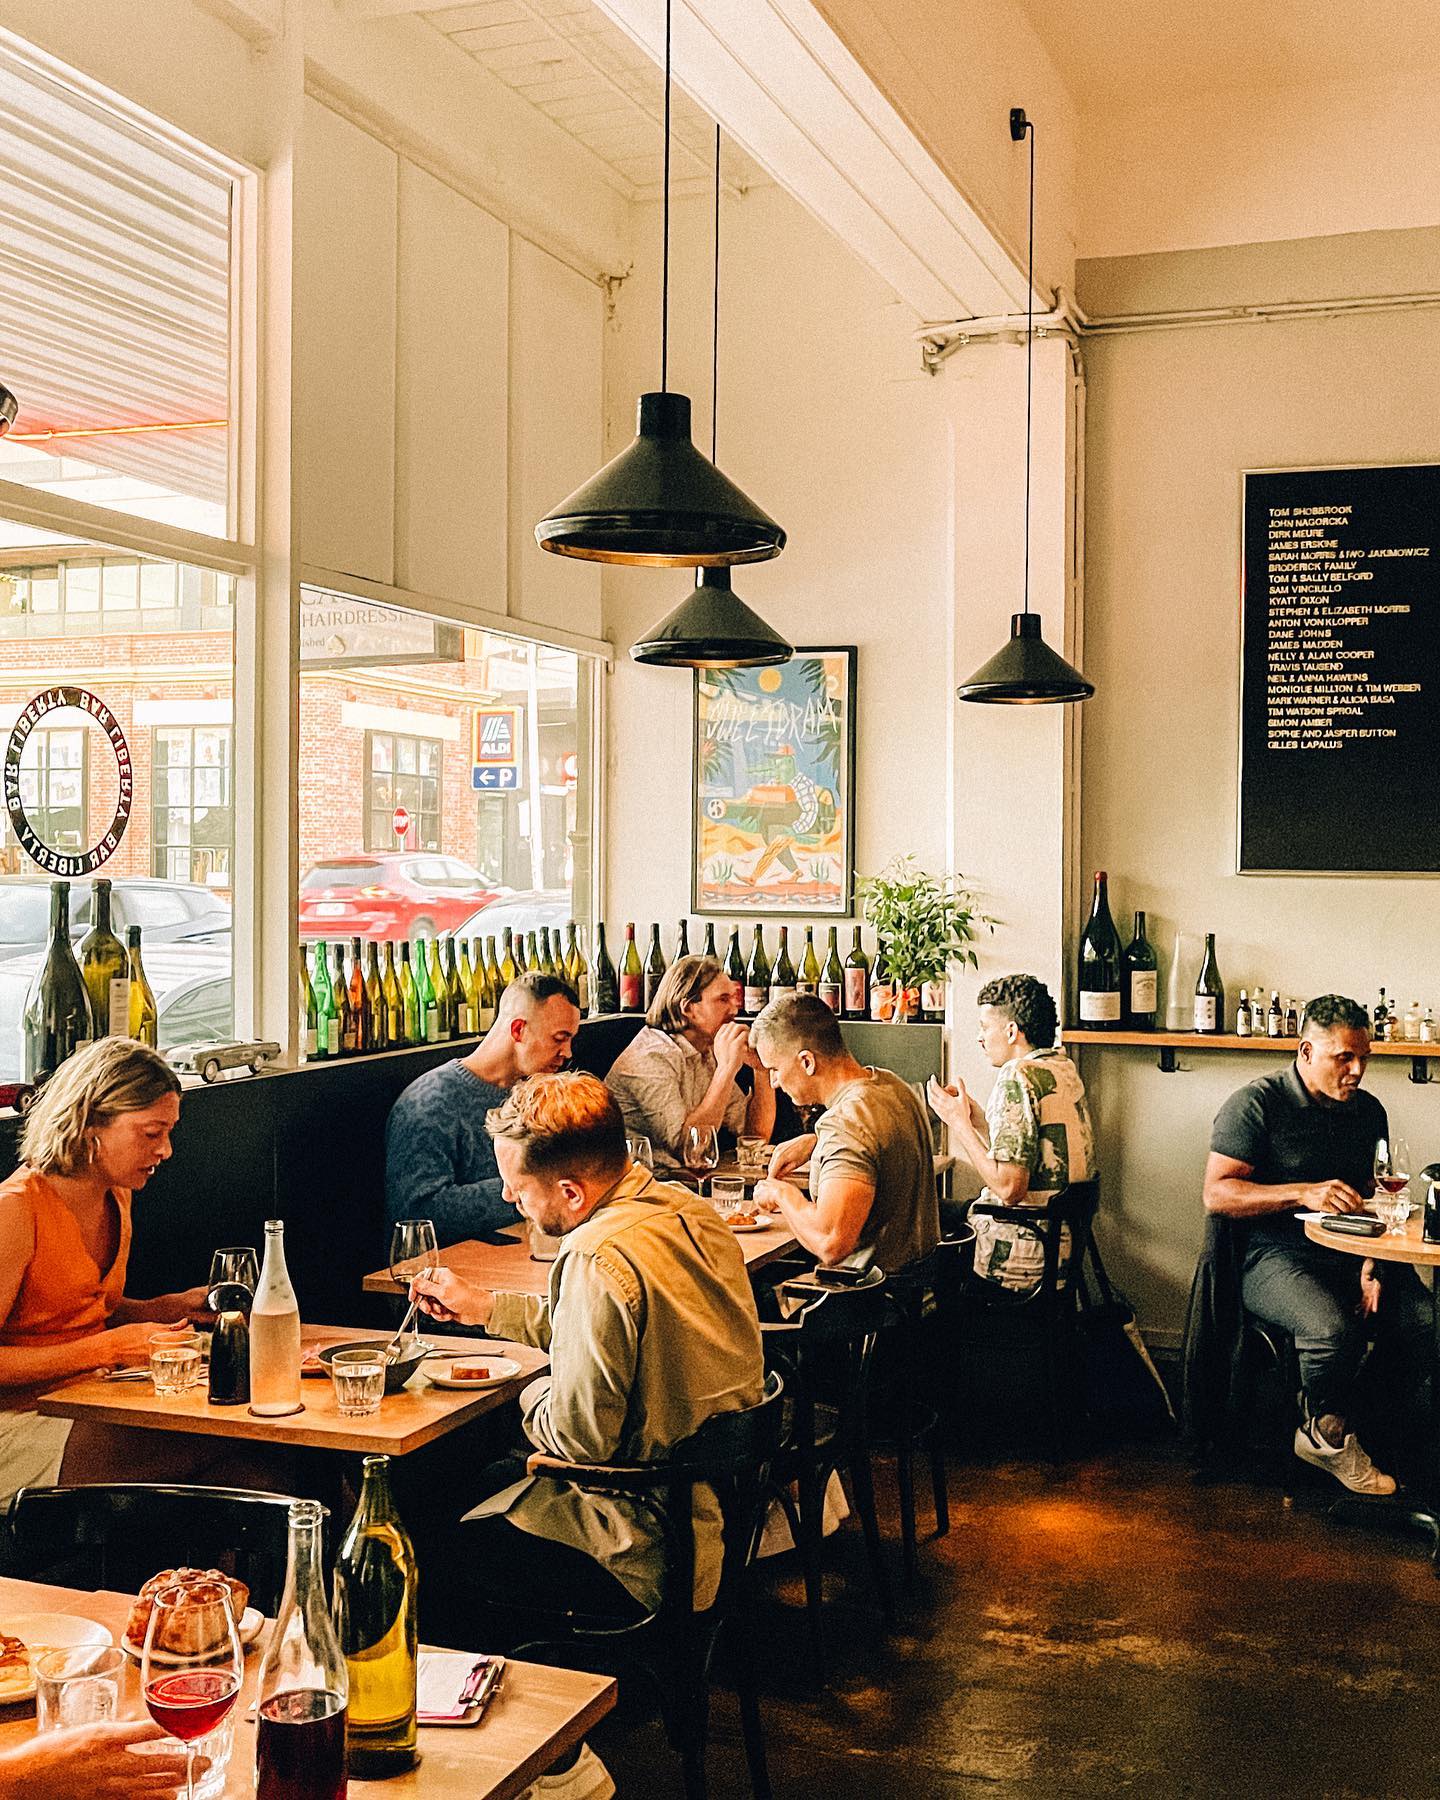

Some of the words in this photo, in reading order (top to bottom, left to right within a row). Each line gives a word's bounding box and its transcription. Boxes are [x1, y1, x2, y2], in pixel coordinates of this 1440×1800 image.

[1269, 508, 1289, 517] TOM
[1269, 519, 1293, 528] JOHN
[1269, 530, 1291, 539] DIRK
[1293, 529, 1324, 538] MEURE
[1268, 542, 1298, 551] JAMES
[1300, 540, 1338, 549] ERSKINE
[1269, 552, 1299, 561] SARAH
[1339, 550, 1344, 559] &
[1269, 563, 1321, 572] BRODERICK
[1325, 561, 1357, 570] FAMILY
[1269, 575, 1289, 584] TOM
[1292, 574, 1297, 583] &
[1300, 573, 1329, 582] SALLY
[1330, 573, 1373, 582] BELFORD
[1269, 586, 1288, 595] SAM
[1292, 585, 1341, 594] VINCIULLO
[1270, 597, 1297, 606] KYATT
[1300, 596, 1329, 605] DIXON
[1269, 608, 1310, 617] STEPHEN
[1313, 607, 1319, 616] &
[1322, 606, 1372, 615] ELIZABETH
[1268, 619, 1300, 628] ANTON
[1304, 618, 1324, 627] VON
[1326, 617, 1368, 626] KLOPPER
[1269, 630, 1294, 639] DANE
[1298, 629, 1331, 638] JOHNS
[1269, 641, 1300, 650] JAMES
[1303, 640, 1343, 649] MADDEN
[1268, 652, 1296, 661] NELLY
[1299, 652, 1304, 661] &
[1308, 651, 1333, 660] ALAN
[1336, 650, 1374, 659] COOPER
[1269, 663, 1300, 672] TRAVIS
[1268, 674, 1287, 683] NEIL
[1289, 674, 1295, 683] &
[1297, 674, 1325, 683] ANNA
[1357, 684, 1363, 693] &
[1365, 684, 1381, 693] TIM
[1267, 696, 1292, 705] MARK
[1293, 696, 1331, 705] WARNER
[1333, 696, 1338, 705] &
[1340, 695, 1369, 704] ALICIA
[1370, 695, 1395, 704] BASA
[1268, 707, 1283, 716] TIM
[1286, 707, 1324, 716] WATSON
[1268, 718, 1298, 727] SIMON
[1268, 730, 1300, 739] SOPHIE
[1302, 729, 1322, 738] AND
[1323, 729, 1358, 738] JASPER
[1359, 729, 1396, 738] BUTTON
[480, 742, 511, 756] ALDI
[1268, 741, 1298, 750] GILLES
[1301, 740, 1342, 749] LAPALUS
[500, 768, 513, 788] P
